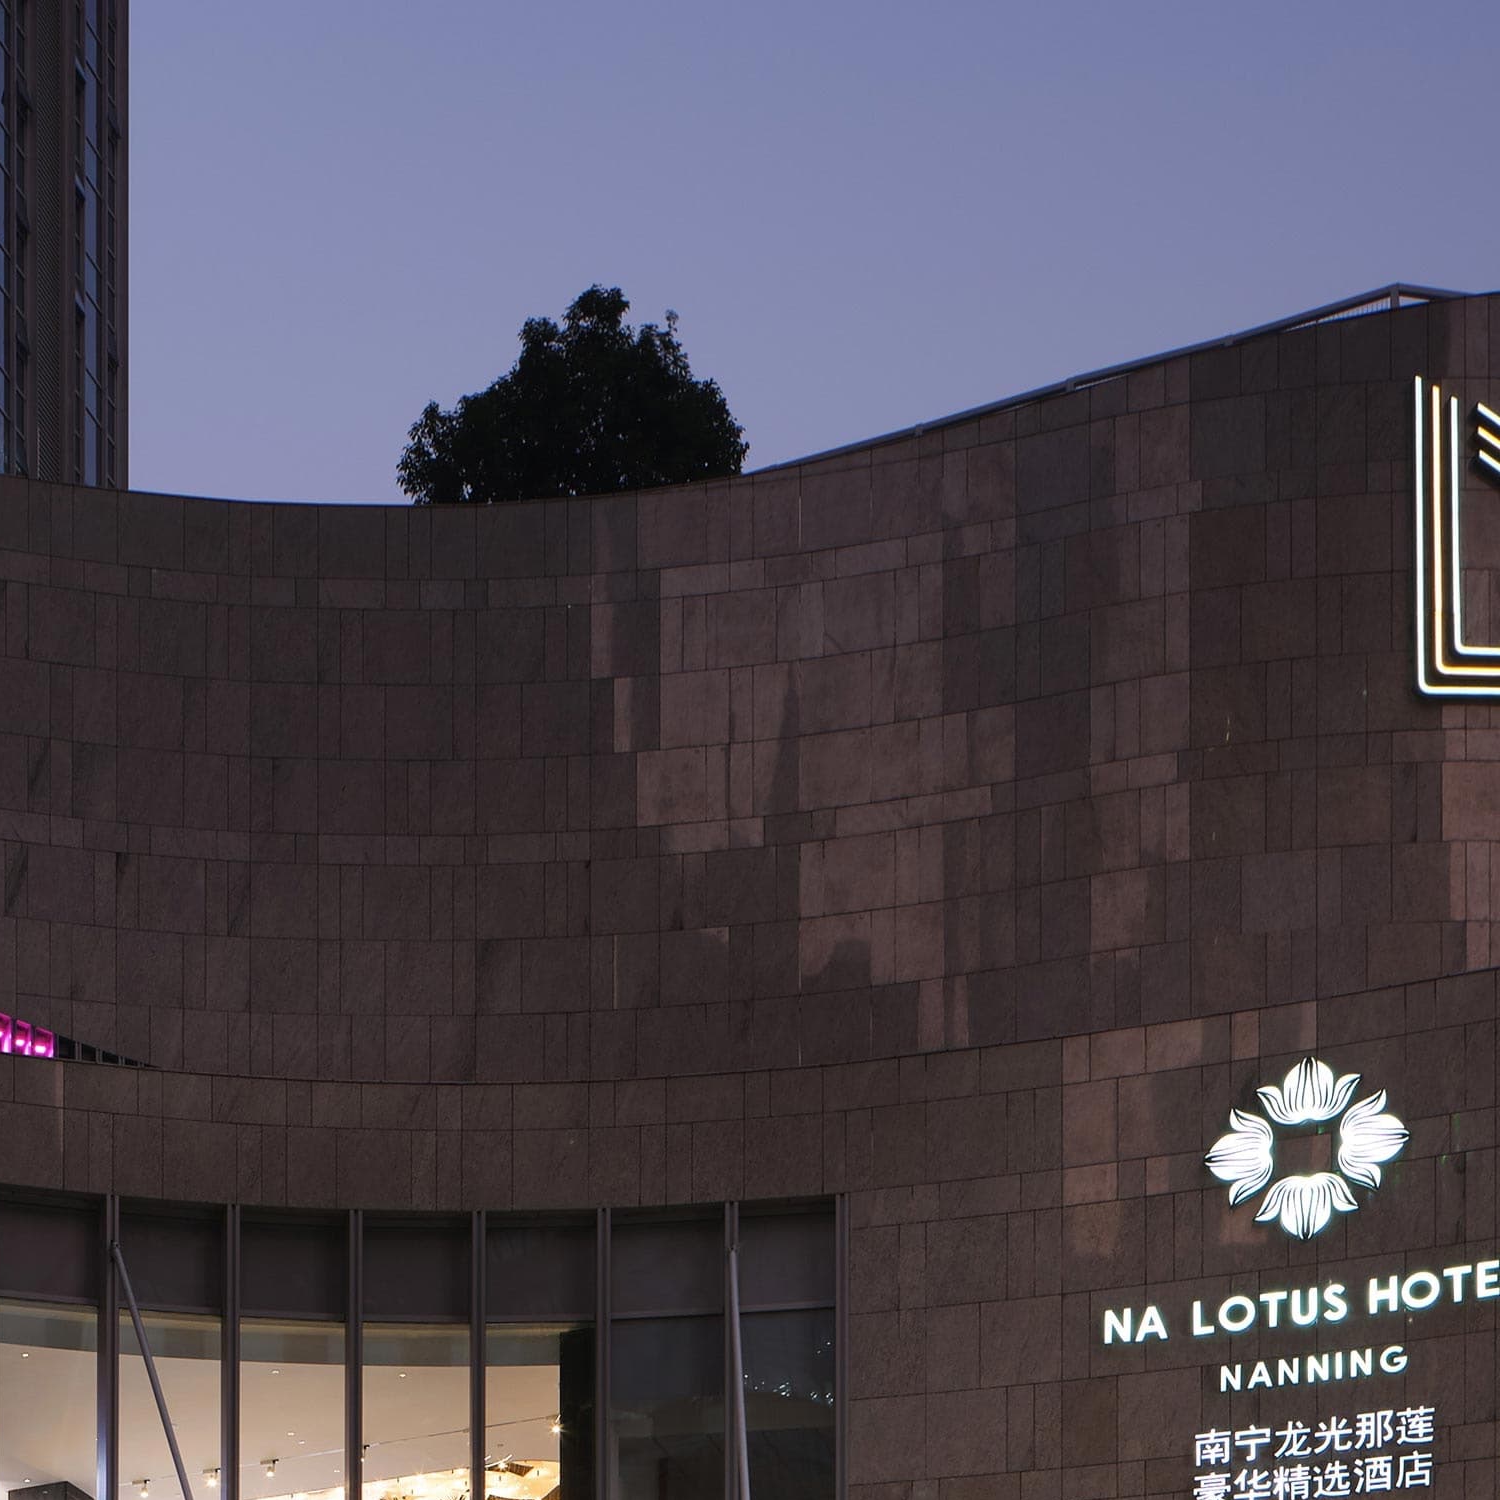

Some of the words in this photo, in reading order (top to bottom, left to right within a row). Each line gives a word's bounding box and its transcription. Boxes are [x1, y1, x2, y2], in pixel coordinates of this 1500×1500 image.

[1103, 1305, 1168, 1344] NA
[1192, 1283, 1348, 1337] LOTUS
[1219, 1345, 1409, 1392] NANNING
[1193, 1405, 1436, 1467] 南宁龙光那莲
